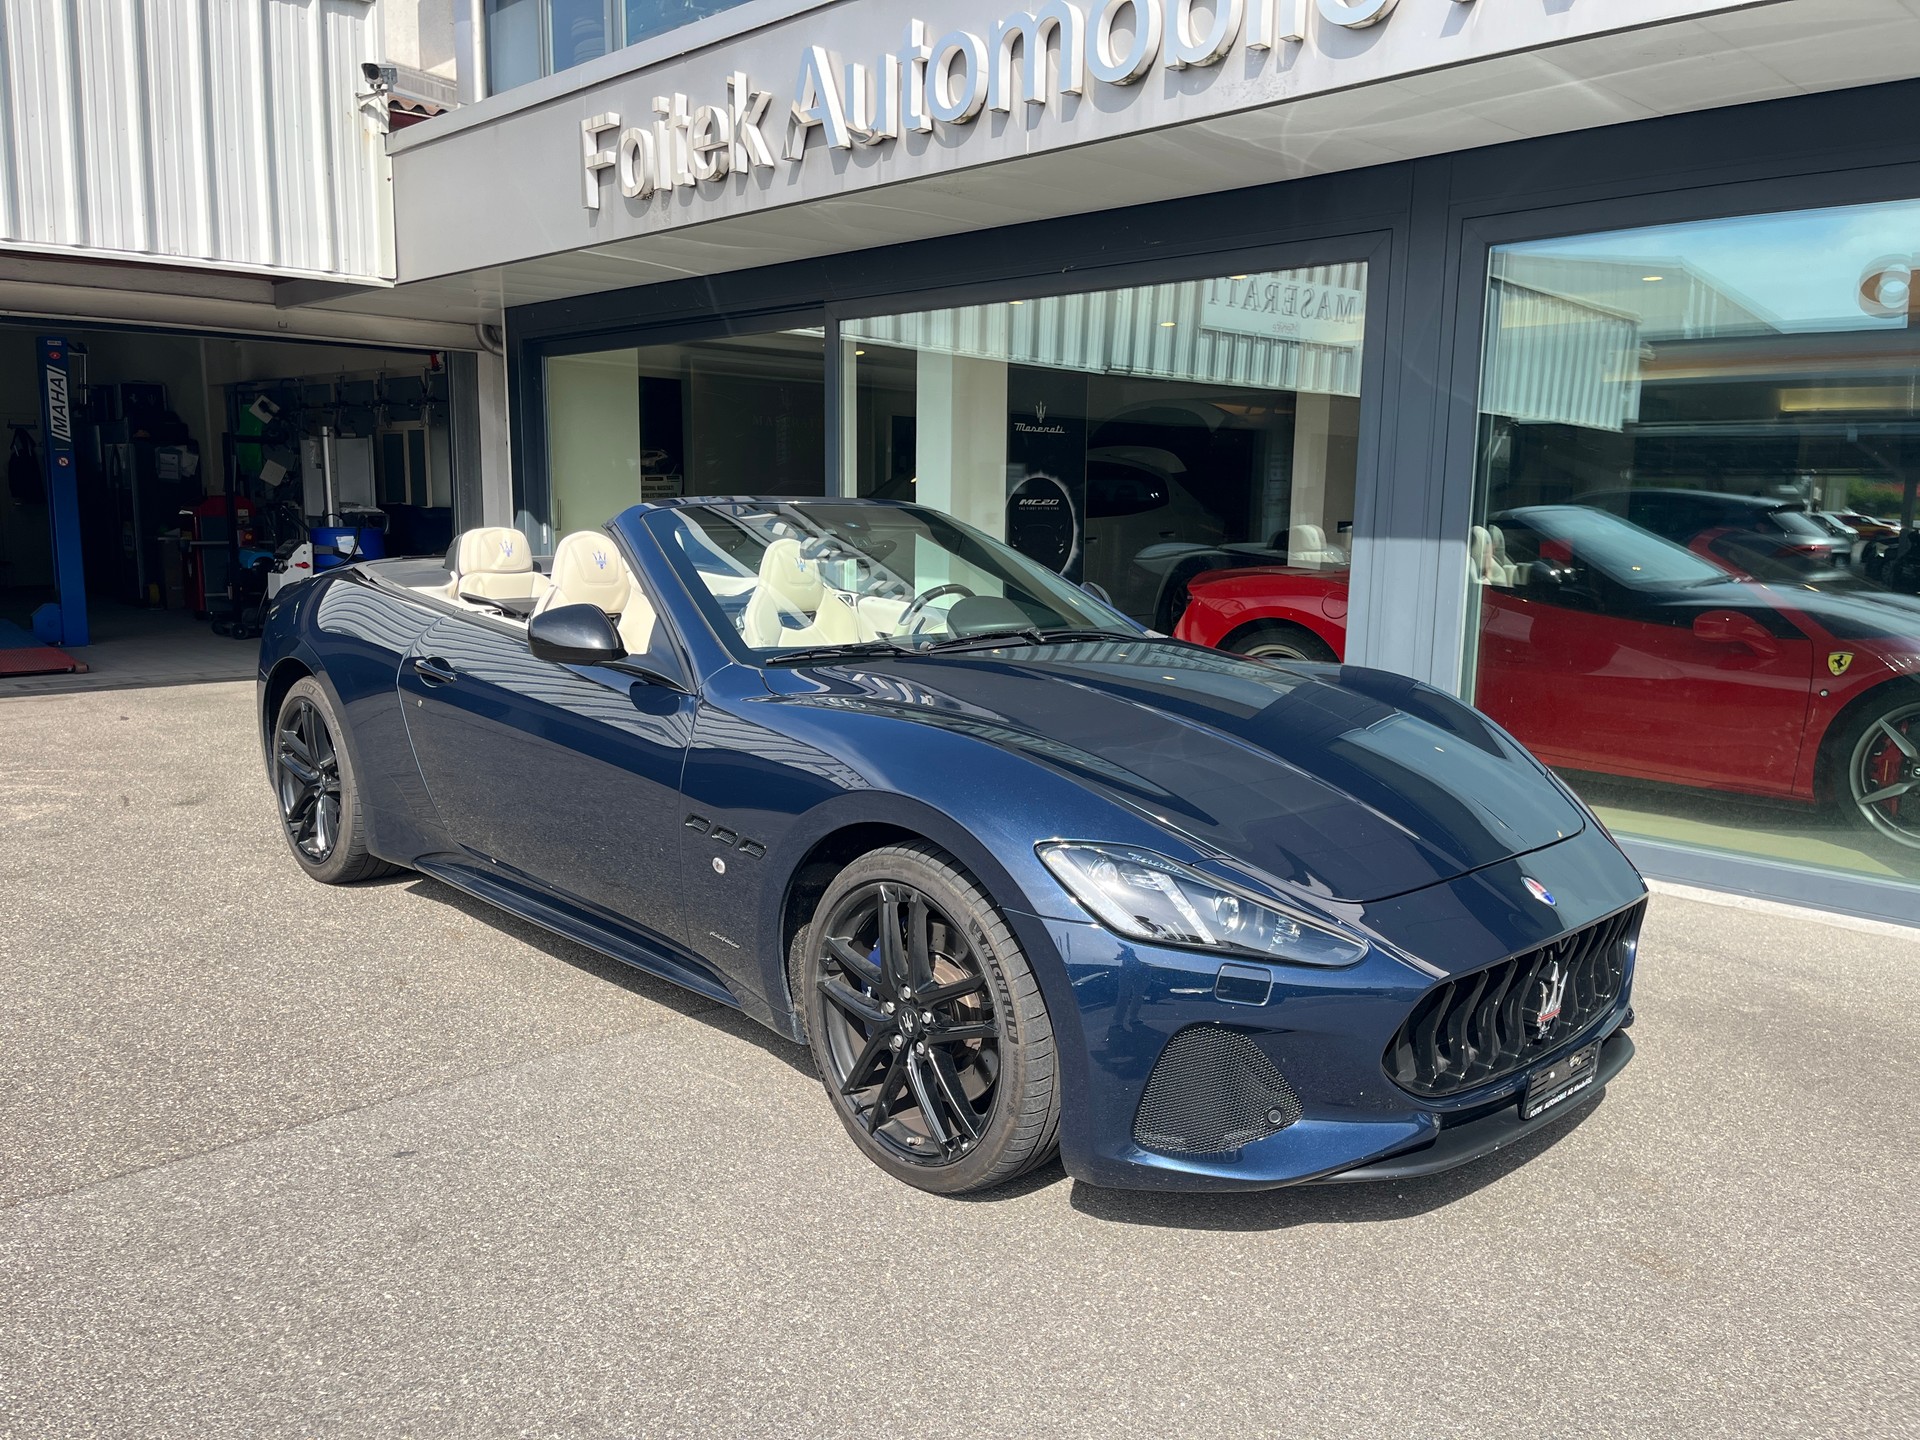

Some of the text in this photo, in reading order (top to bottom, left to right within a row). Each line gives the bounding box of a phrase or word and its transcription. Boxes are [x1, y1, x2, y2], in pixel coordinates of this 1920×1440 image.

[580, 0, 1399, 209] Foitek Automob
[50, 377, 68, 433] MAHA
[1014, 422, 1066, 434] Maserati
[981, 943, 1019, 1041] MICHELIN
